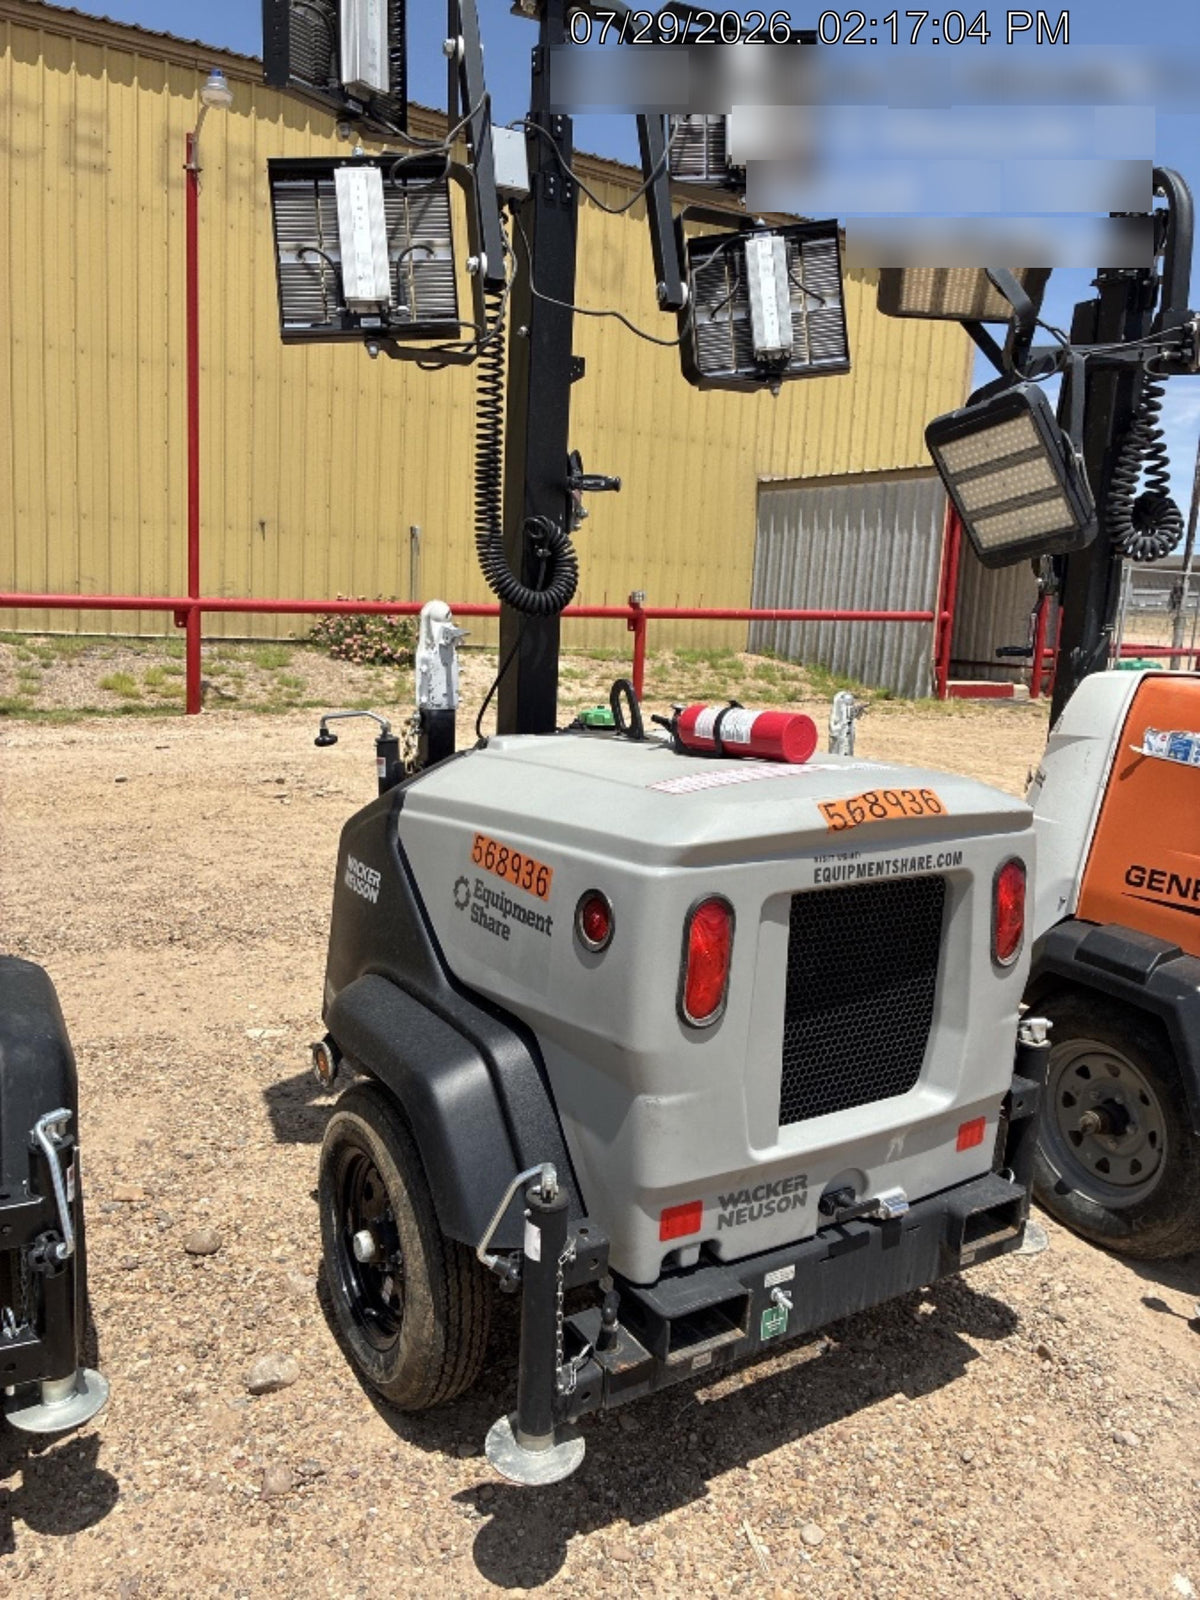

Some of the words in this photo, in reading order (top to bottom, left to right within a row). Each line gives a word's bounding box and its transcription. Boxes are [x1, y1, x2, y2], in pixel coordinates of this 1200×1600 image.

[824, 788, 942, 832] 568936
[472, 834, 549, 897] 568936
[814, 851, 962, 884] EQUIPMENTSHARE.COM
[470, 902, 511, 941] Share
[473, 878, 554, 938] Equipment
[717, 1174, 808, 1211] WACKER
[717, 1191, 808, 1231] NEUSON
